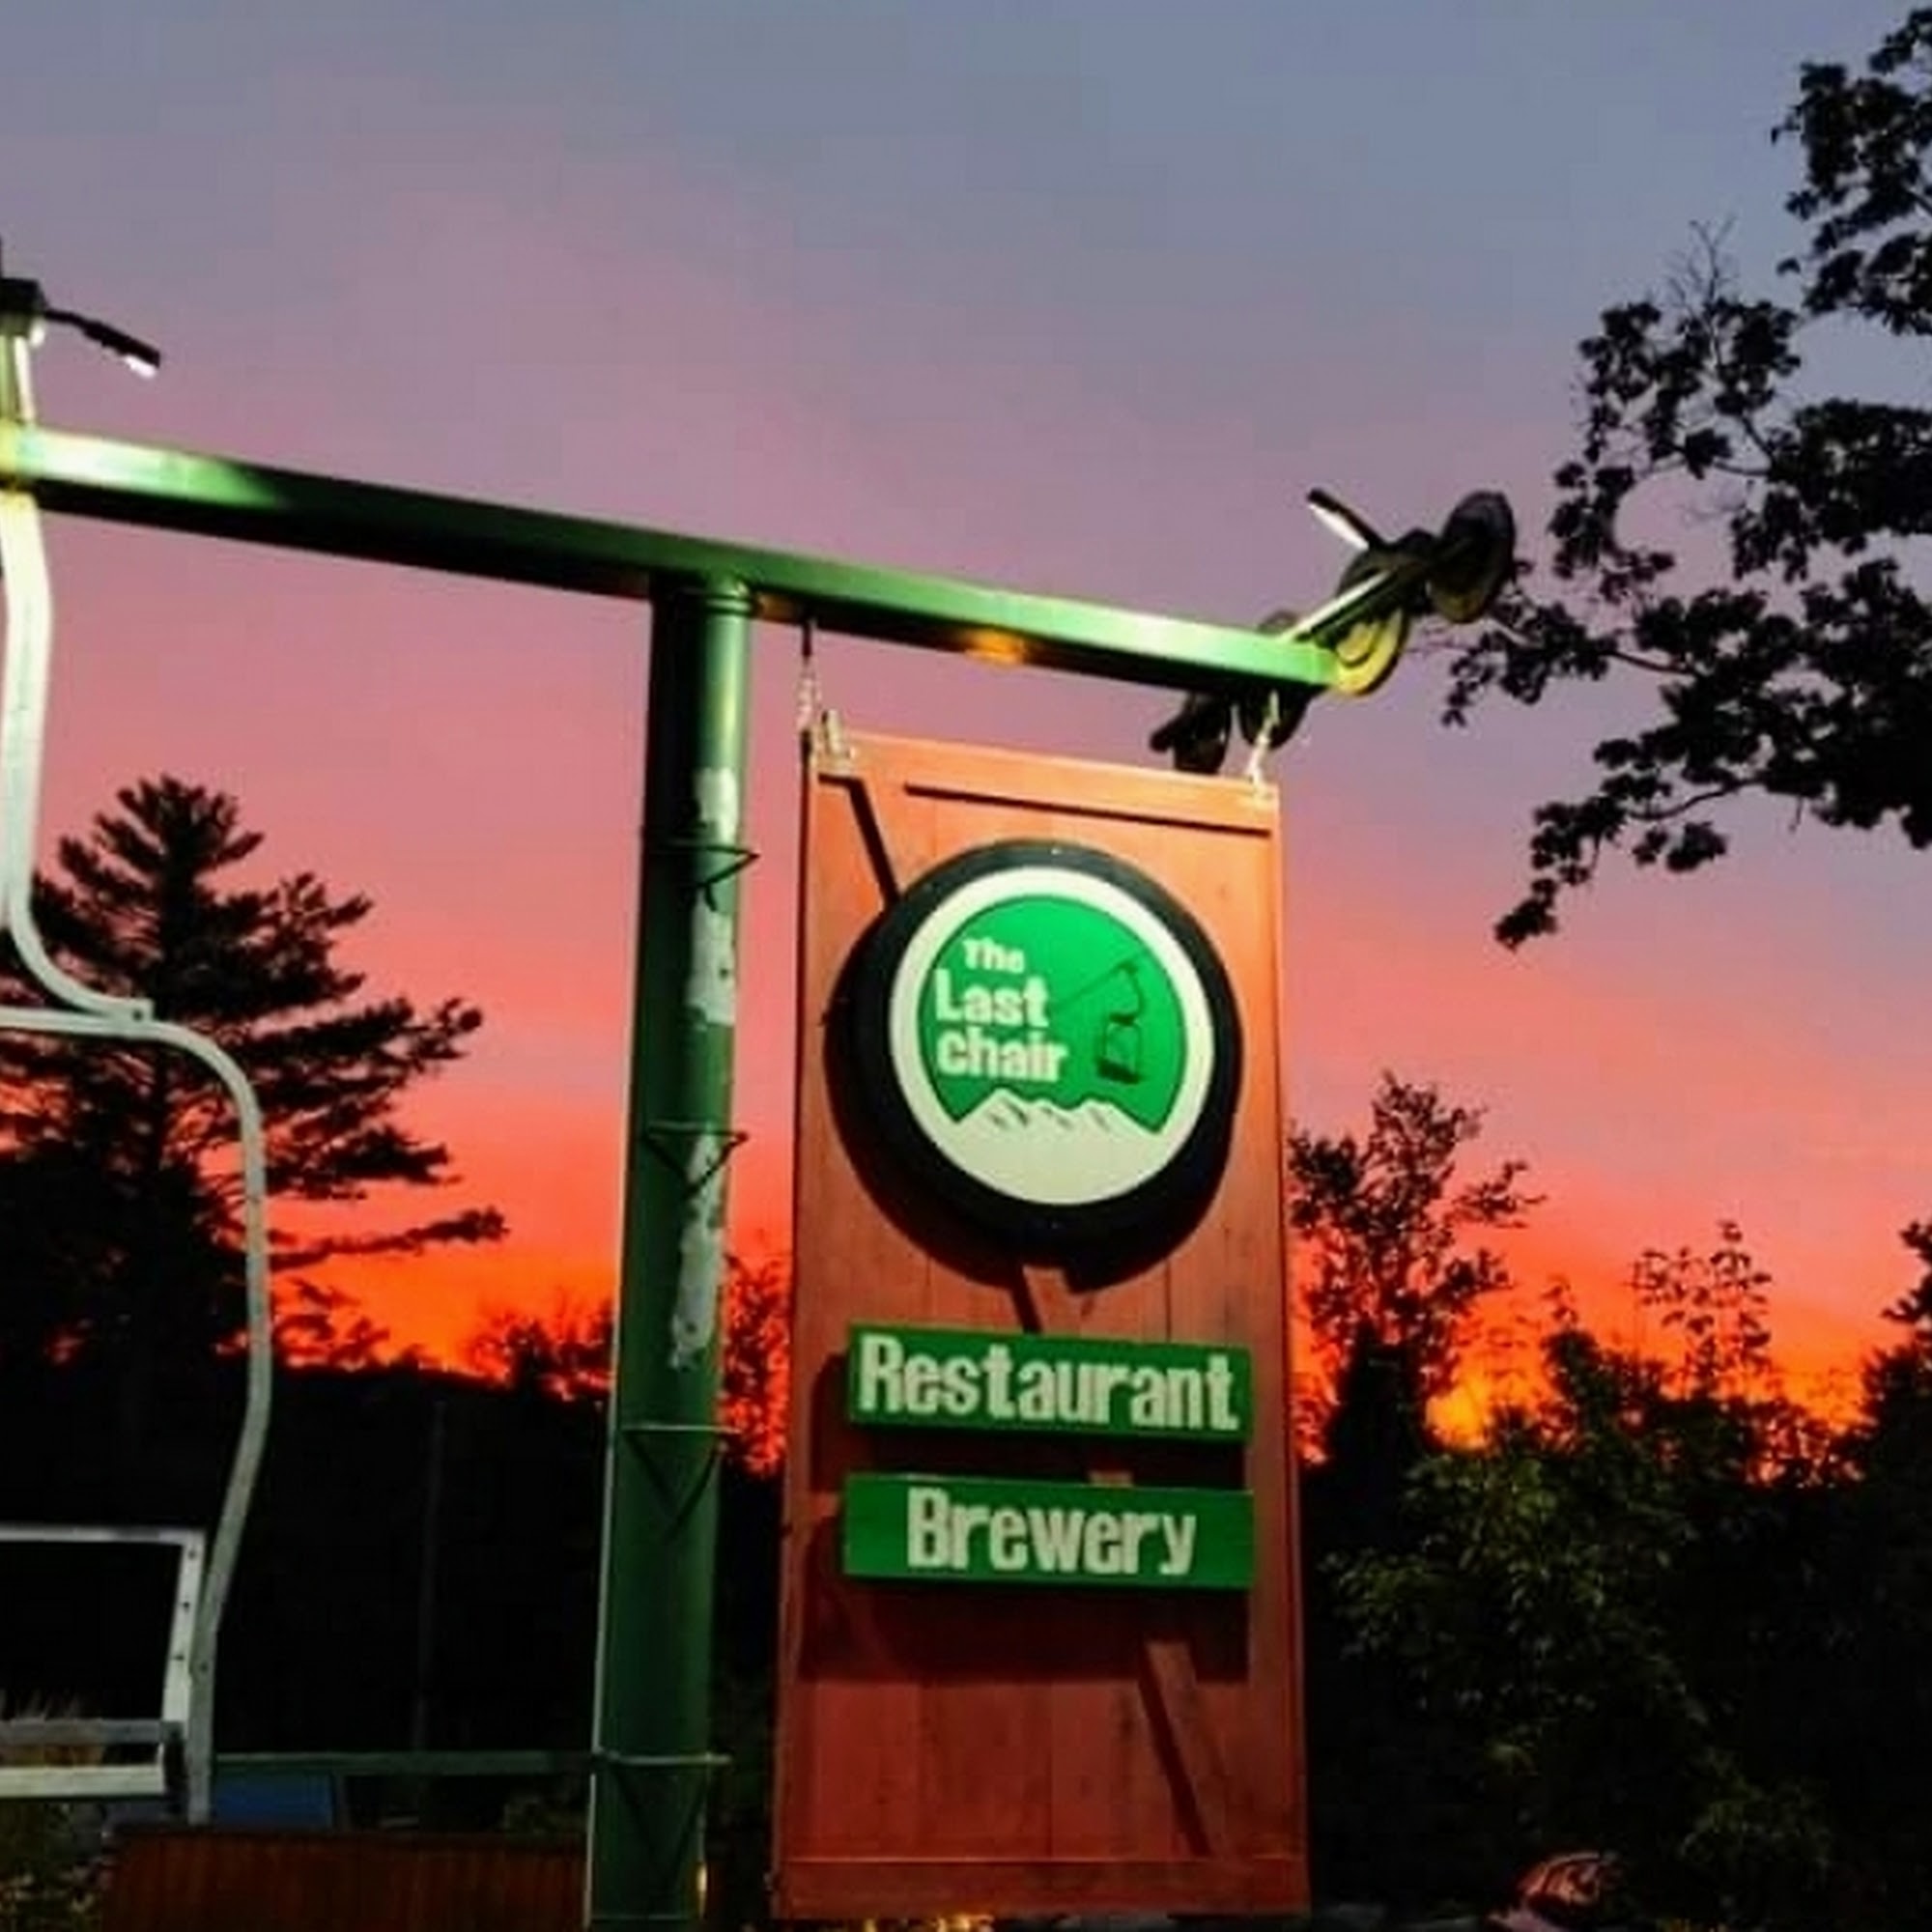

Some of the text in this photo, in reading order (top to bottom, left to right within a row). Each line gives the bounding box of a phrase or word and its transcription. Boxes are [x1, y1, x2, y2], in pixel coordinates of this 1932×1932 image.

[962, 936, 1025, 974] The
[935, 968, 1050, 1027] Last
[859, 1332, 1240, 1432] Restaurant
[906, 1487, 1197, 1576] Brewery
